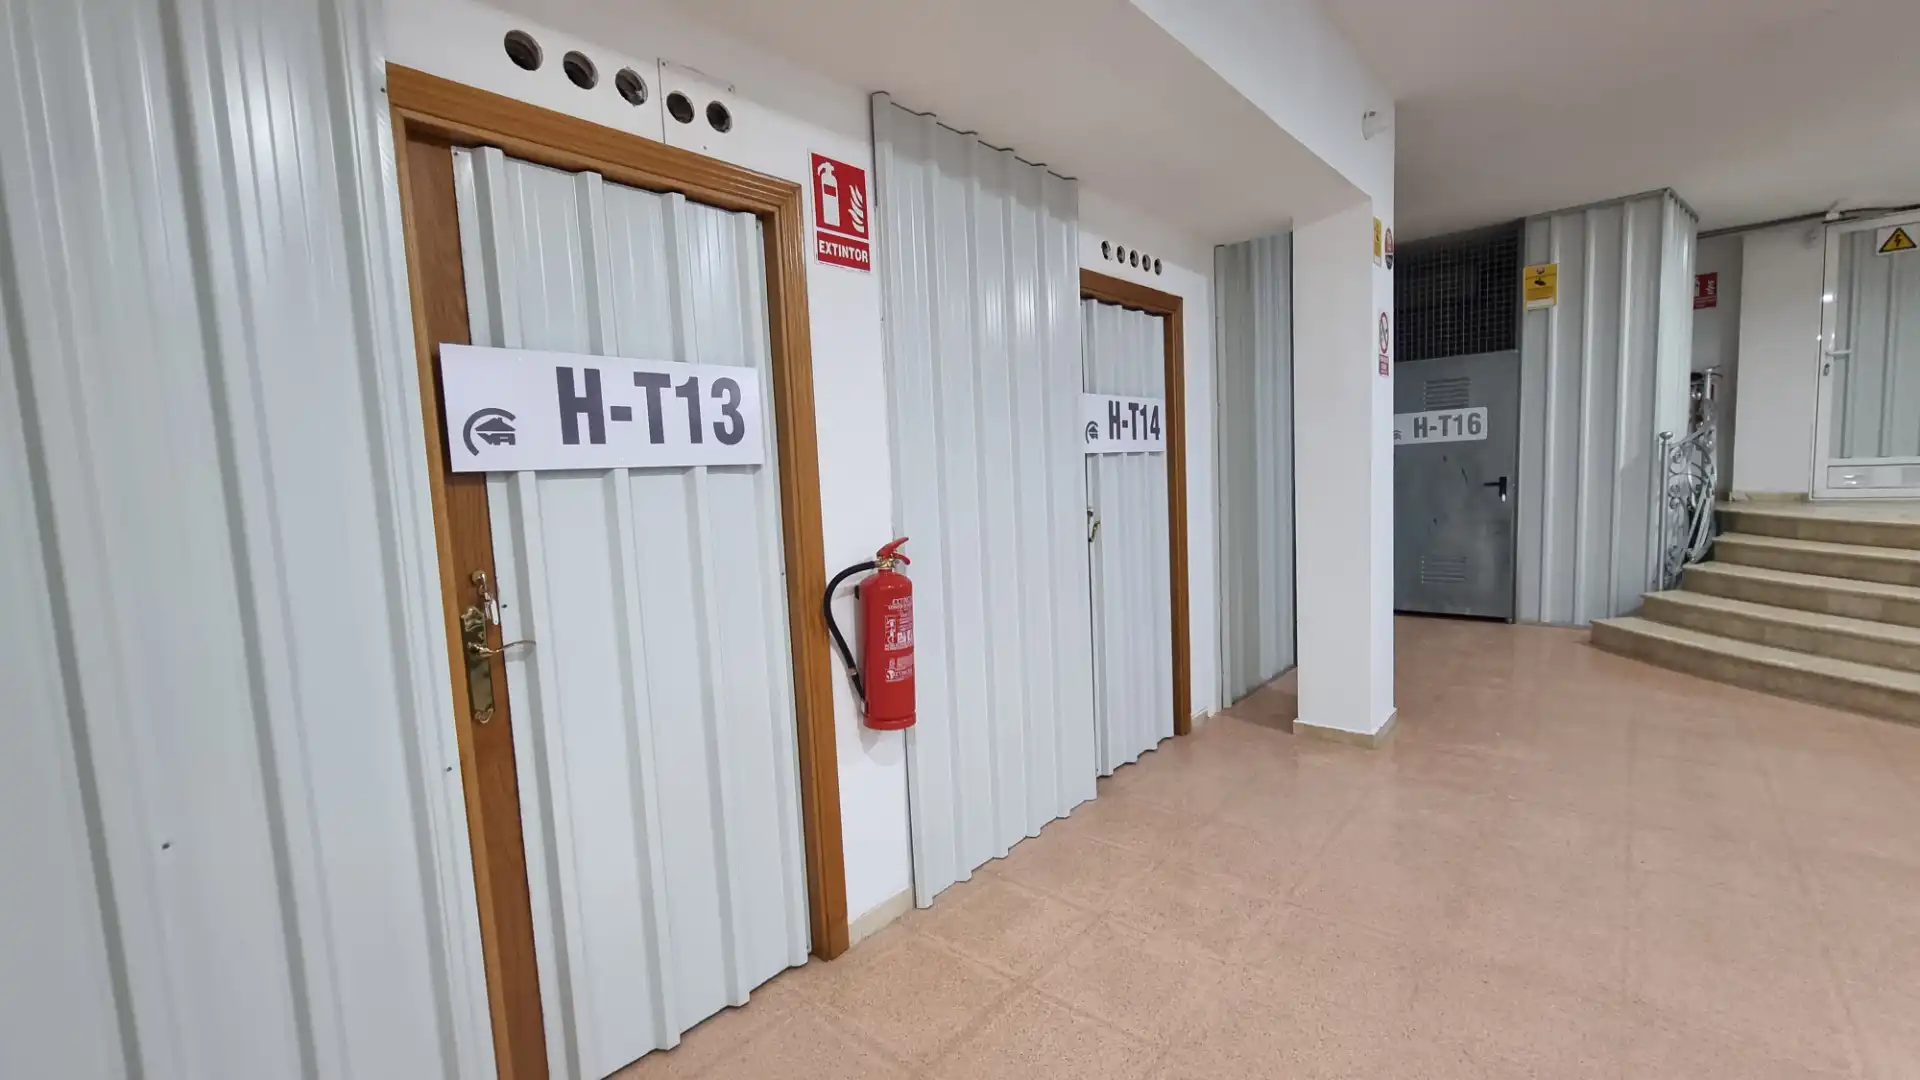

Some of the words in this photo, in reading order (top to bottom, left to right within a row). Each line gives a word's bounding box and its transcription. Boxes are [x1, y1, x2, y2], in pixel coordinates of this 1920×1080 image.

[819, 240, 868, 263] EXTINTOR
[556, 366, 745, 445] H-T13
[1108, 400, 1160, 440] H-T14
[1413, 413, 1481, 438] H-T16
